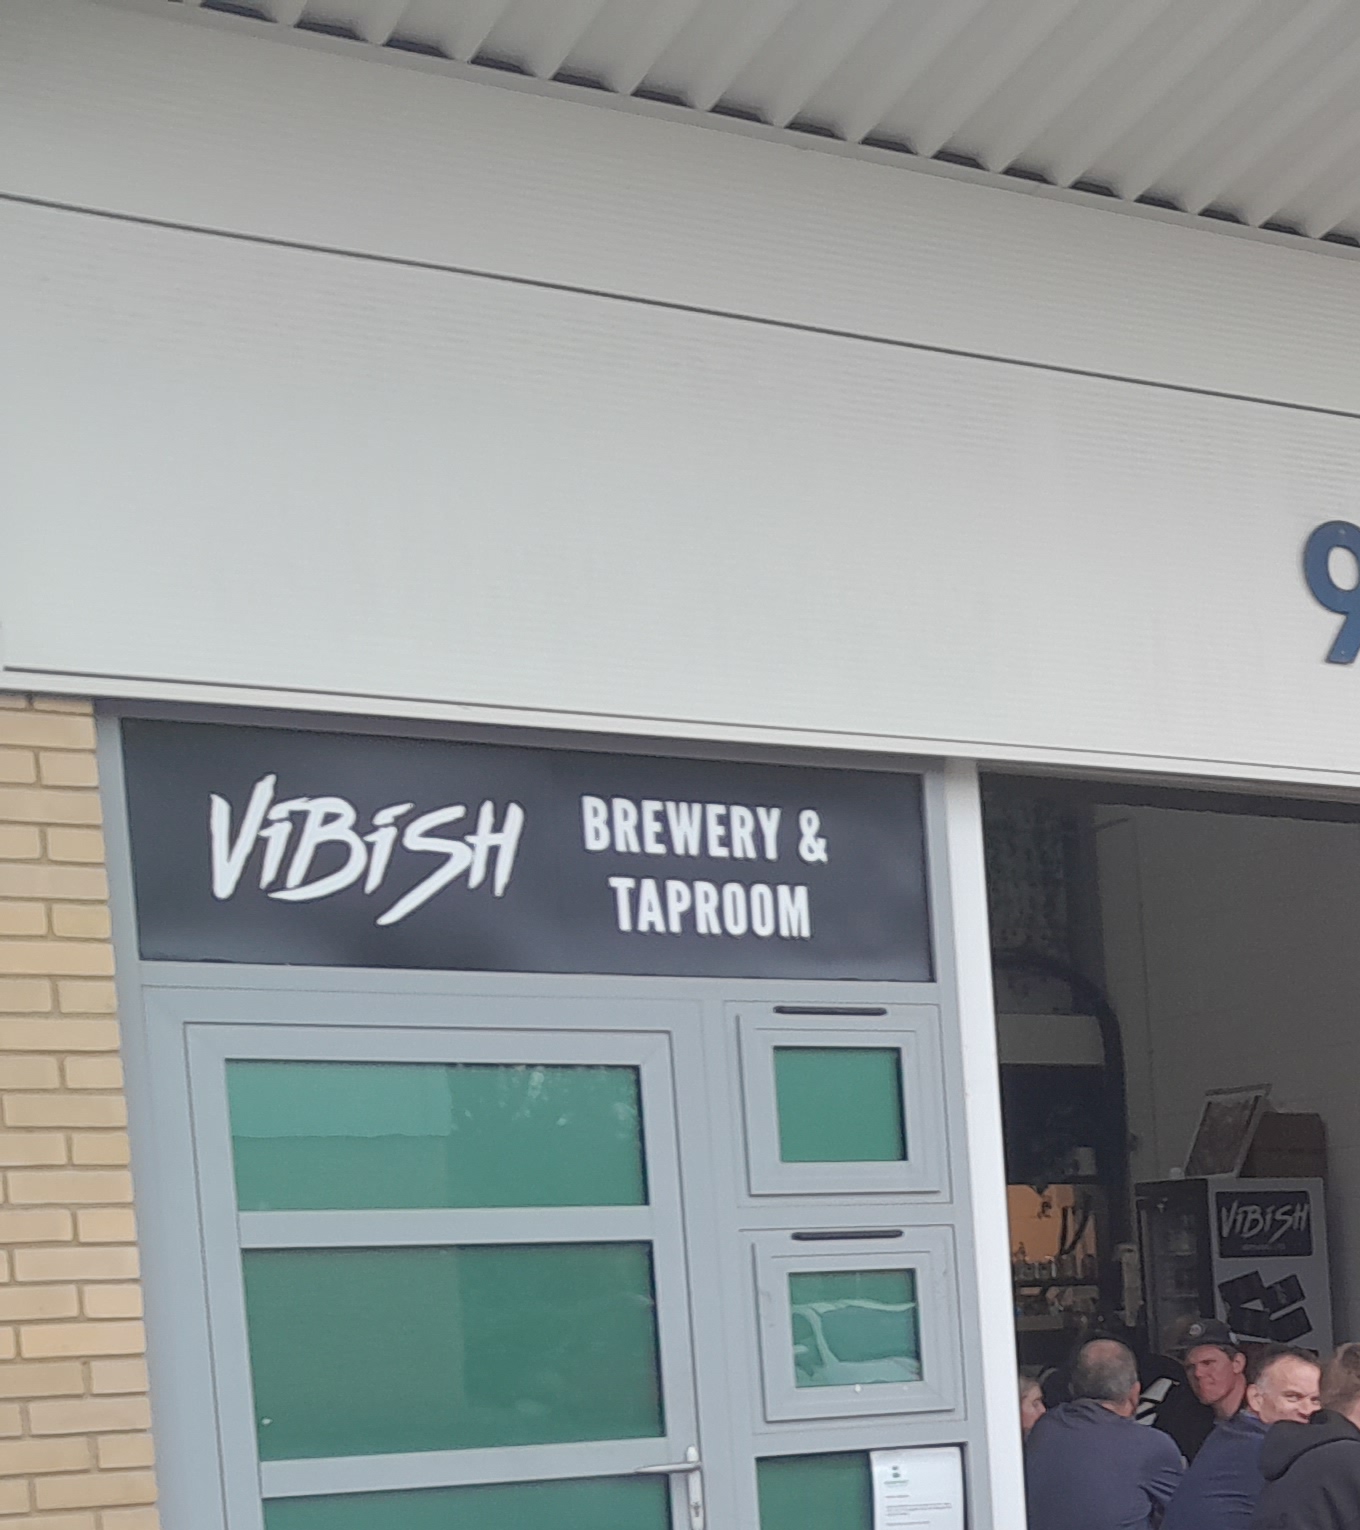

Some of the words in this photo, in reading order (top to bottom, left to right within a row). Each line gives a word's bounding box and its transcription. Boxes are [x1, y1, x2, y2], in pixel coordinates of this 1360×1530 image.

[581, 794, 782, 861] BREWERY
[799, 808, 830, 865] &
[607, 875, 813, 940] TAPROOM
